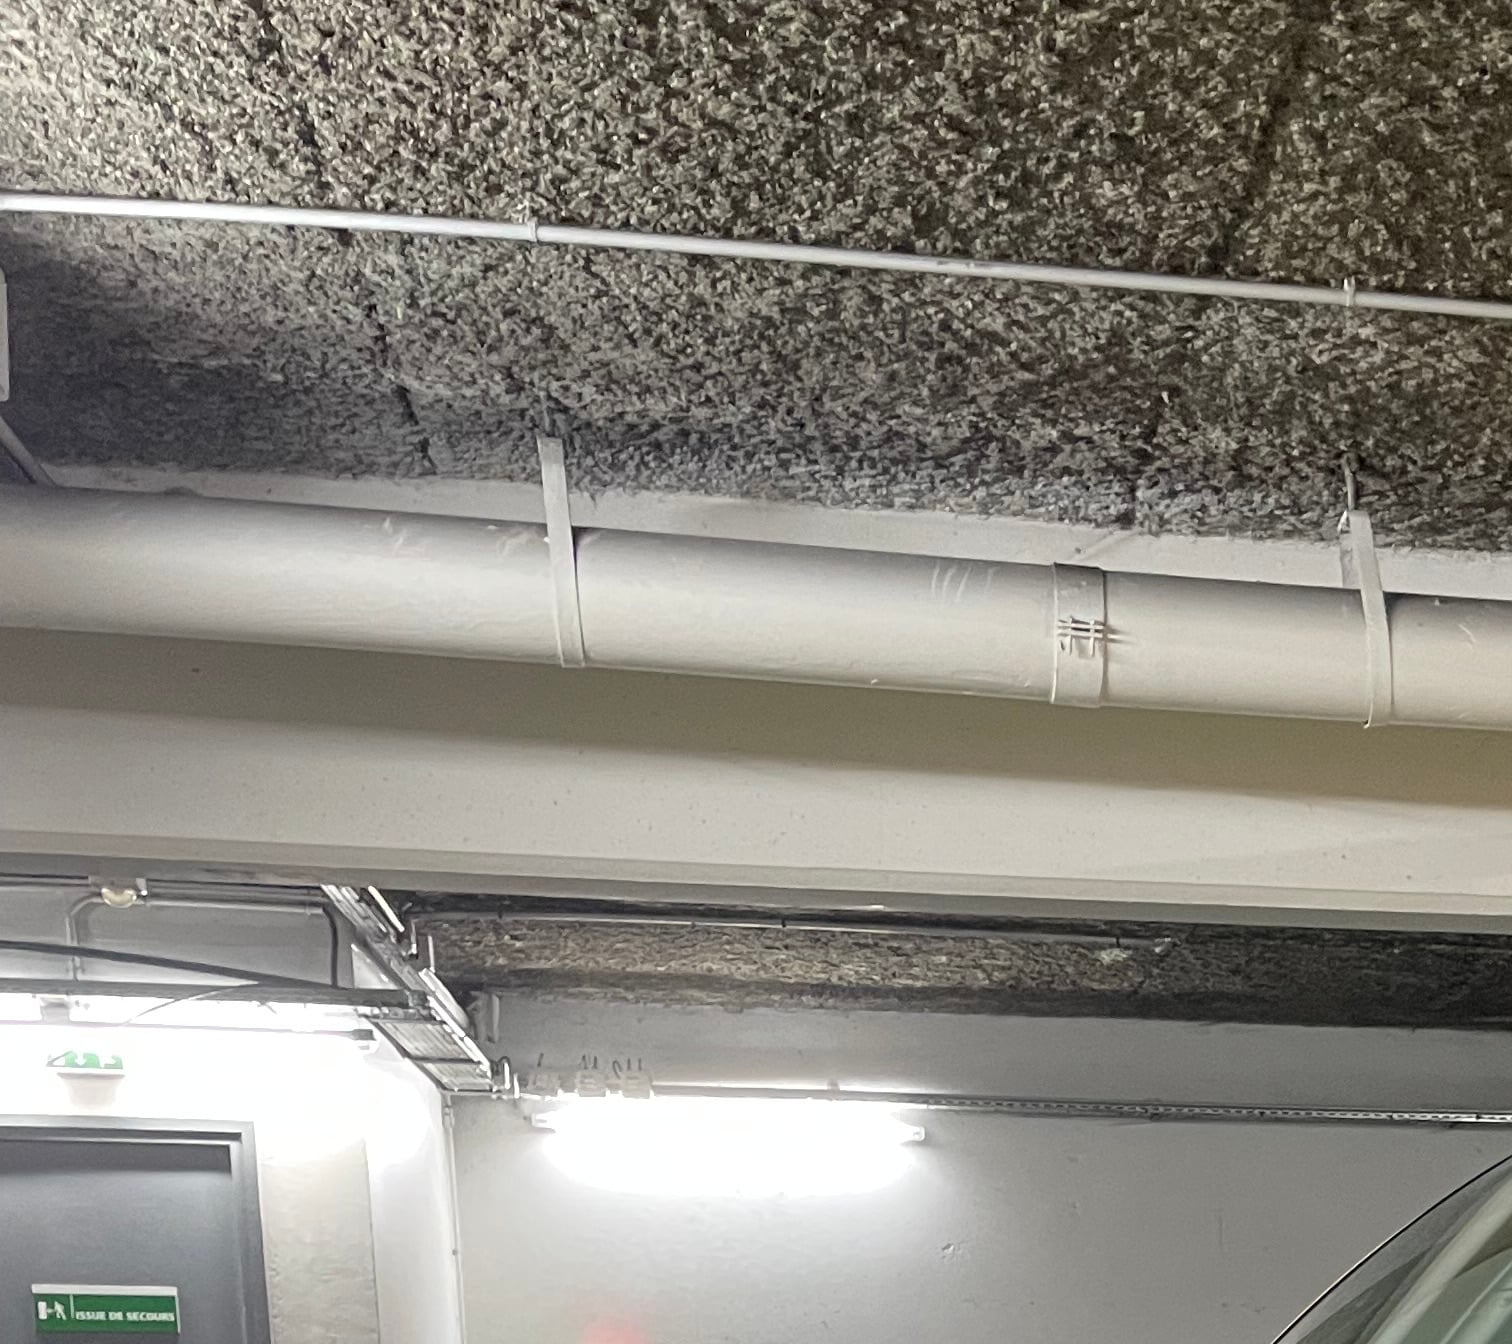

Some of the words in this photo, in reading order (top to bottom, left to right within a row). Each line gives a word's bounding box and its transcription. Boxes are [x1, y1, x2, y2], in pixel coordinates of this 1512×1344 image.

[76, 1311, 105, 1320] ISSUE
[108, 1311, 123, 1321] DE
[126, 1311, 175, 1322] SECOURS
